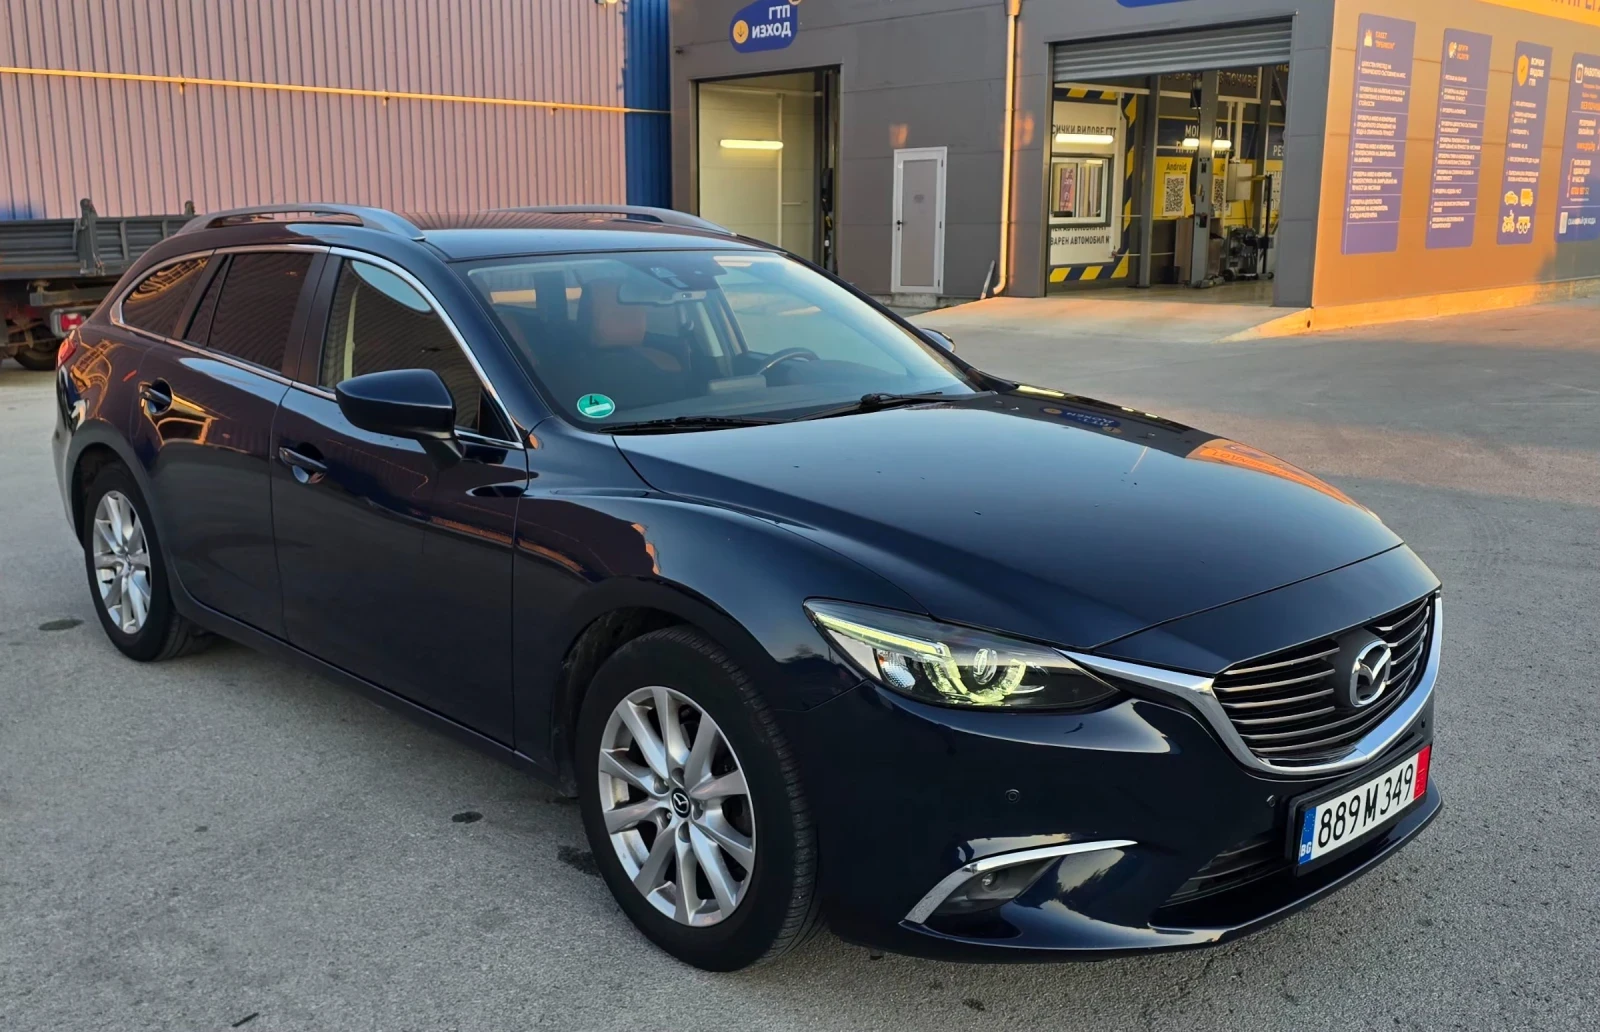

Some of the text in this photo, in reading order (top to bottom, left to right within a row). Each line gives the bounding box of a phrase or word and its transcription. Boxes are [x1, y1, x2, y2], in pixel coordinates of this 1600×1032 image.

[769, 5, 790, 20] ГТП
[752, 22, 791, 38] ИЗХОД
[1166, 161, 1187, 171] Android
[1070, 235, 1105, 245] АВТОМОБИЛ
[1300, 841, 1312, 857] BG
